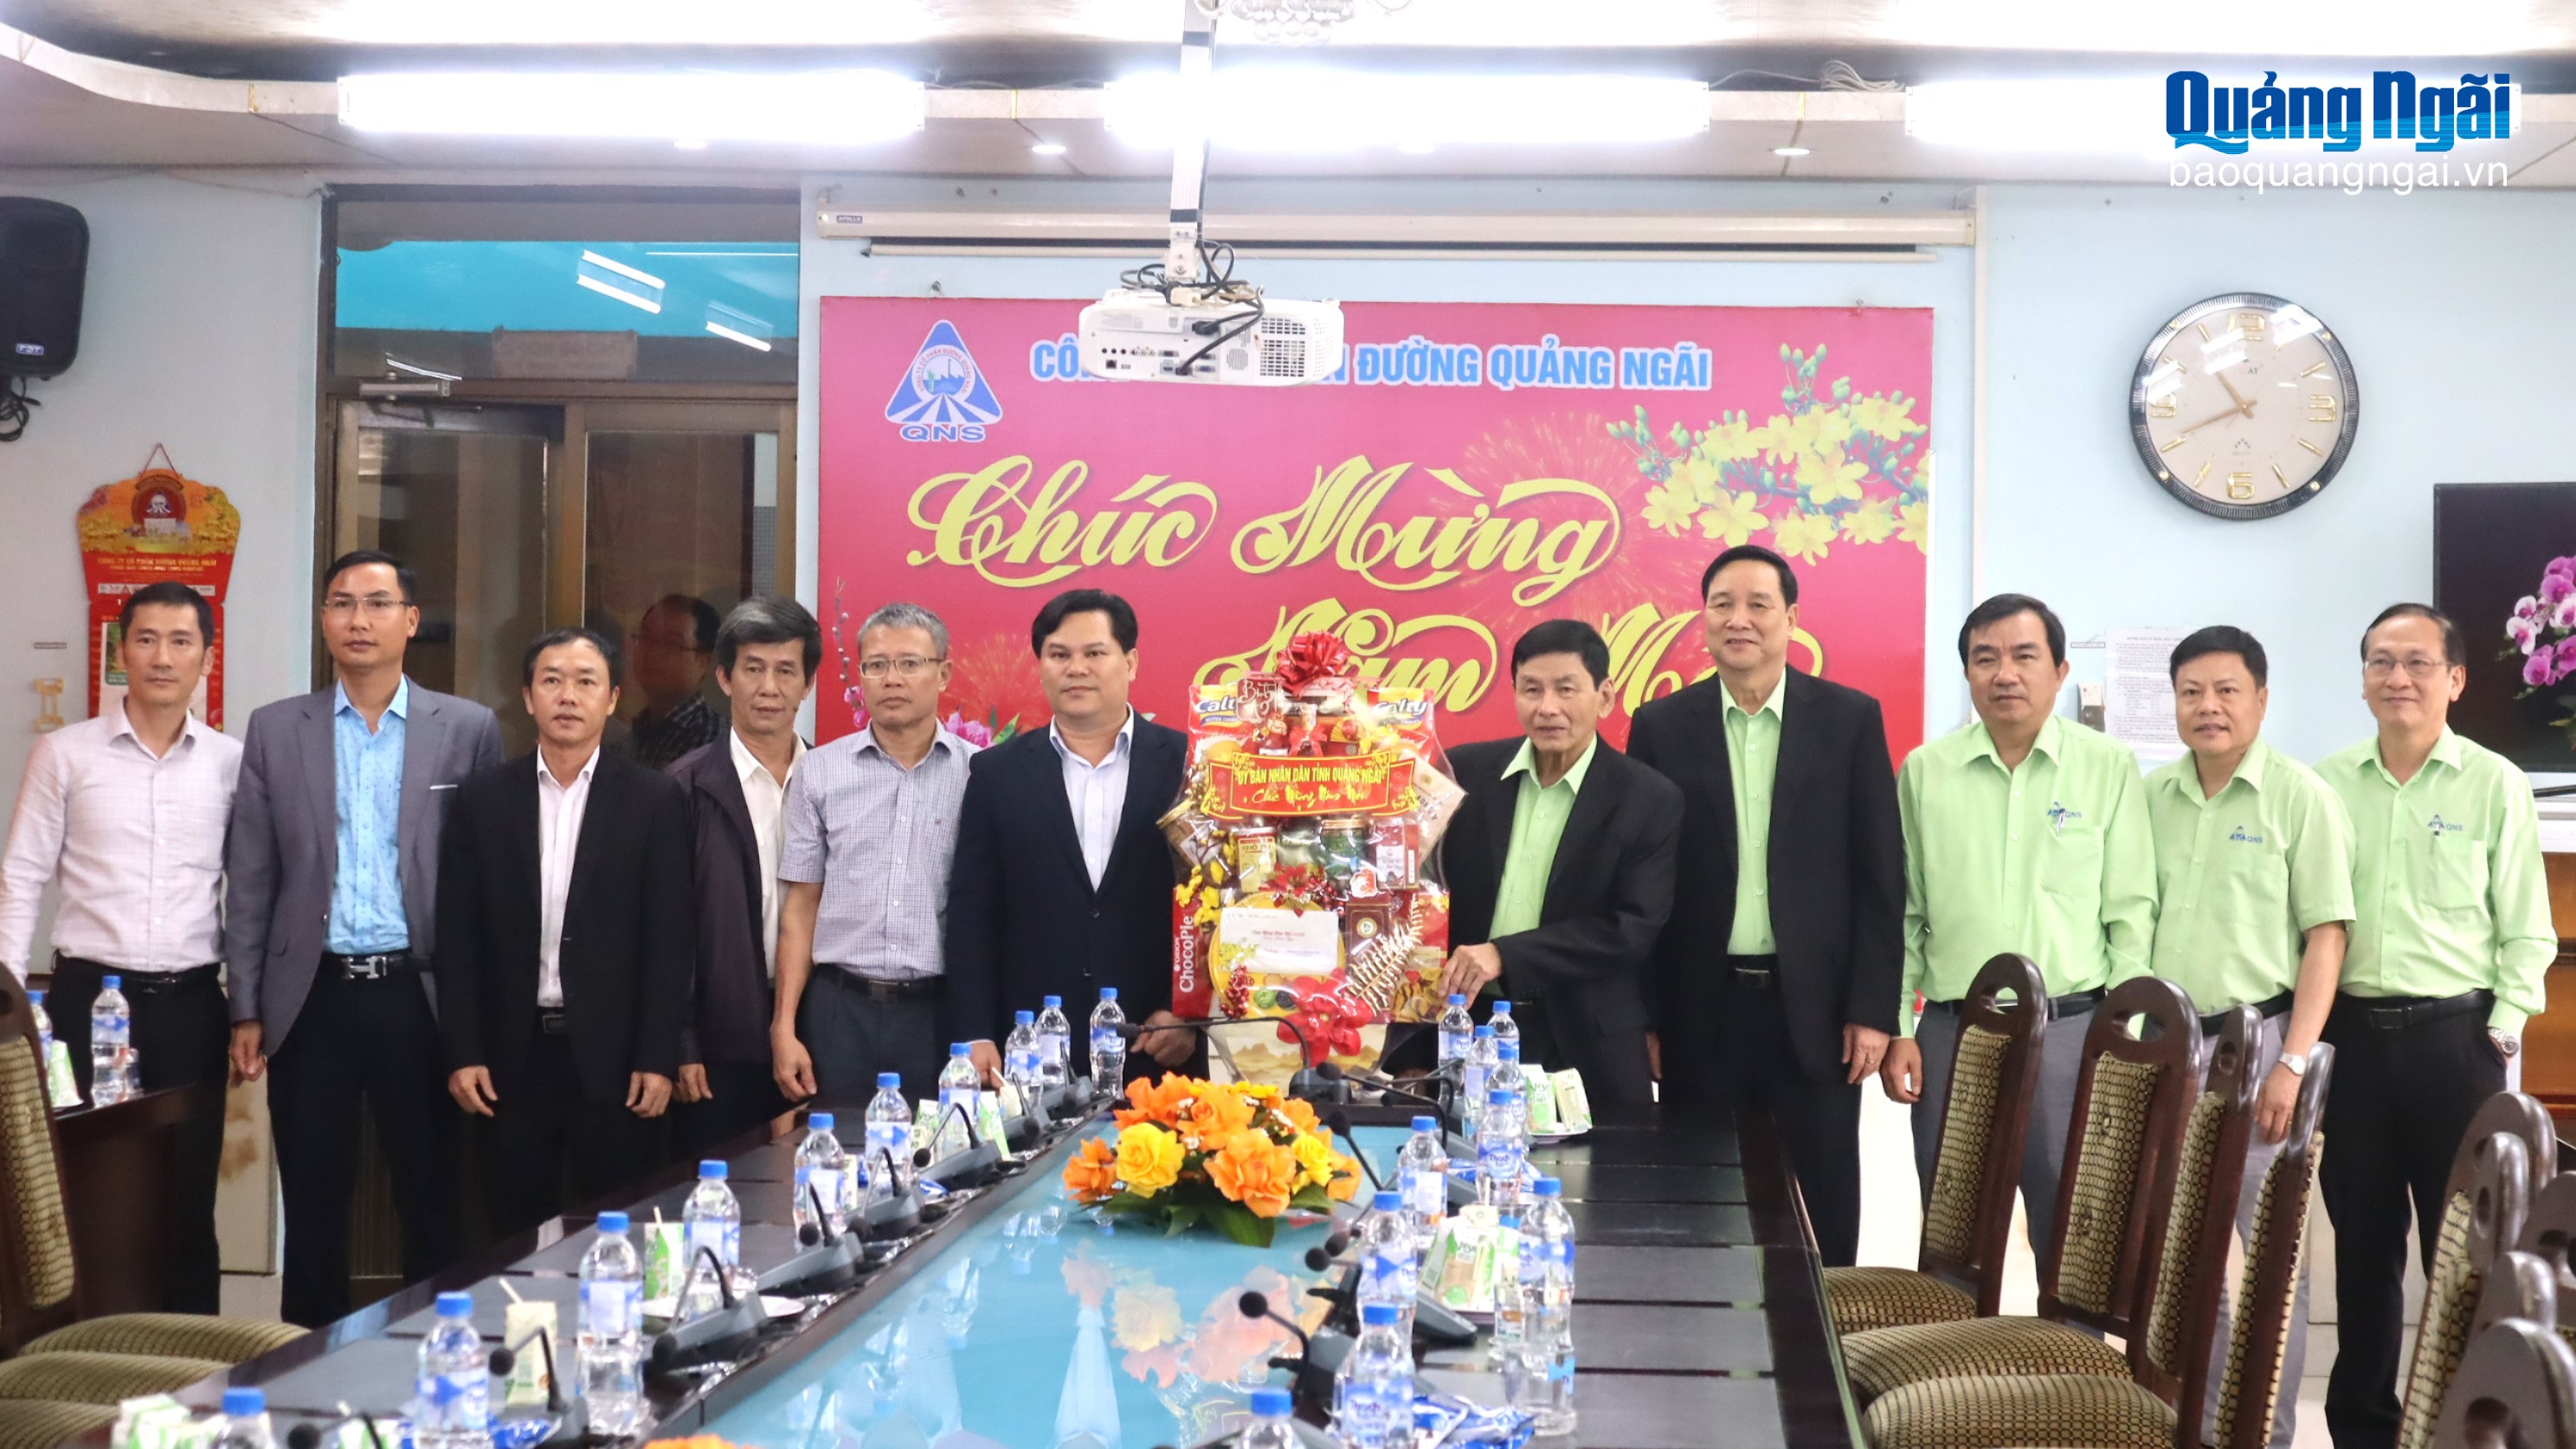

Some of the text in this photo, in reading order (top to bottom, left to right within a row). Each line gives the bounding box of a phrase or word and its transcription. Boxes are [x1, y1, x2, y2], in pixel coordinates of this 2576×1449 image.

[1356, 341, 1478, 383] ĐƯỜNG
[1491, 336, 1612, 388] QUẢNG
[1622, 343, 1710, 388] NGÃI
[2309, 395, 2337, 422] 3
[900, 425, 984, 441] QNS
[2227, 472, 2255, 499] 6
[906, 454, 1621, 607] Chúc Mừng
[2246, 835, 2264, 844] QNS
